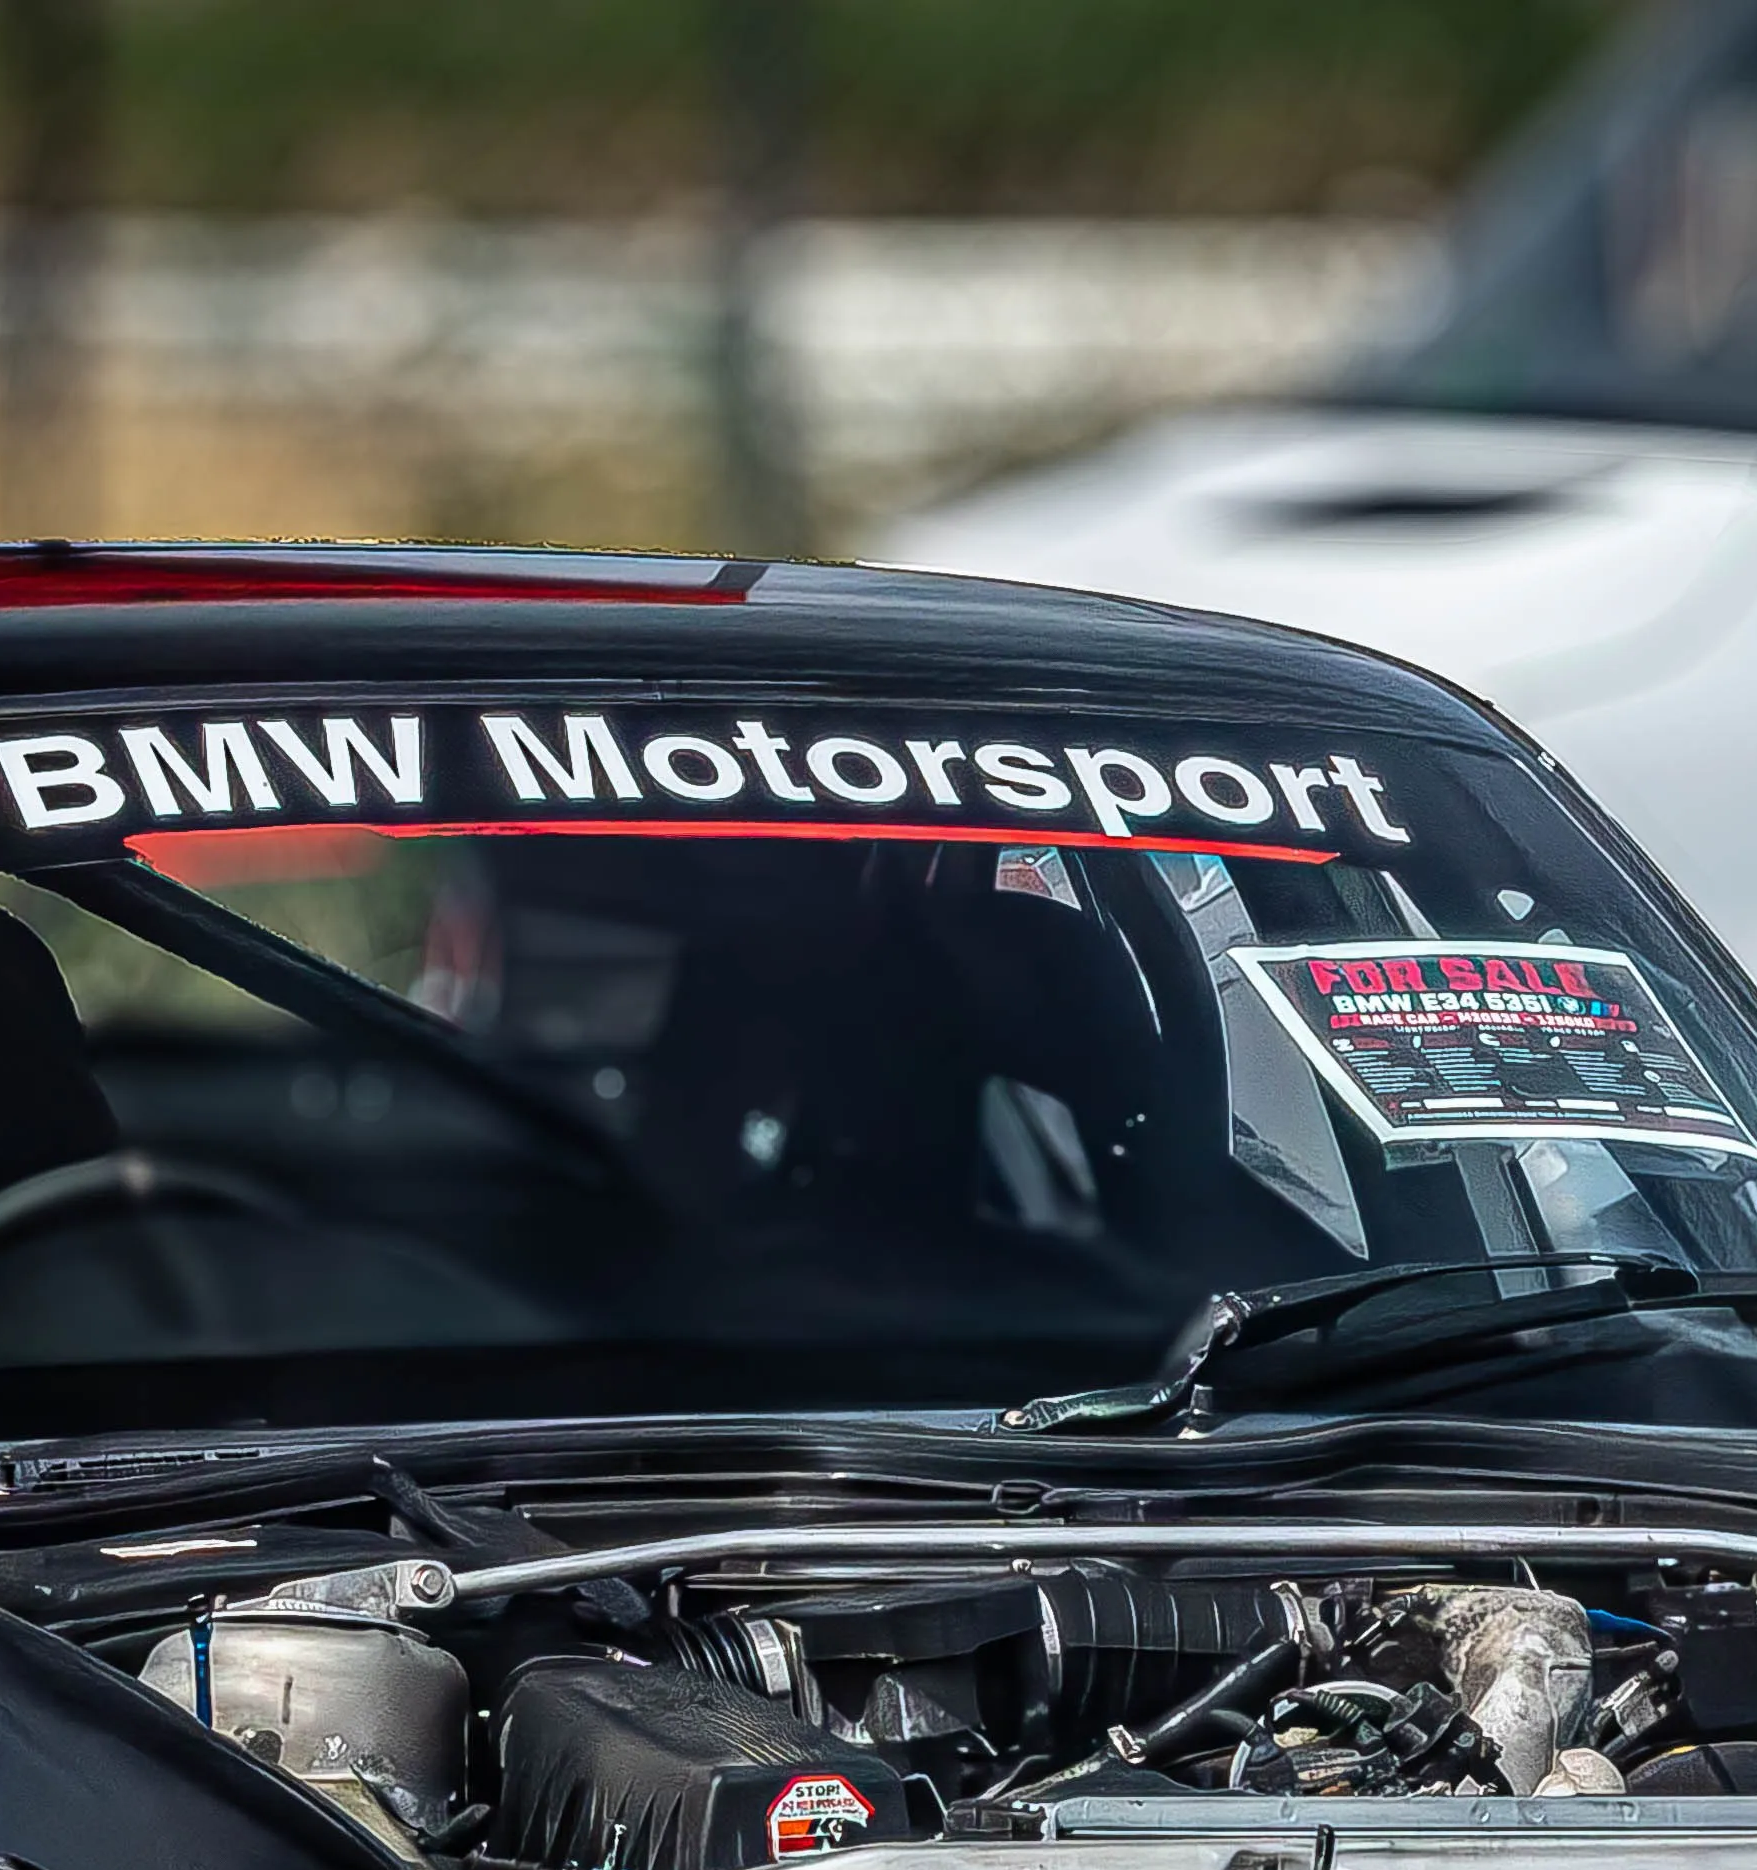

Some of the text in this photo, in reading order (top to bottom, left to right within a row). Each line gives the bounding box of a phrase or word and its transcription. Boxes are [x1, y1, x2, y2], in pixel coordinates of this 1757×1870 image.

[480, 712, 1411, 843] Motorsport
[1308, 956, 1605, 1001] FOR SALE
[1332, 994, 1413, 1014] BMW
[1419, 991, 1480, 1013] E34
[1359, 1012, 1405, 1027] RACE
[1406, 1012, 1440, 1025] CAR
[795, 1784, 841, 1798] STOP!
